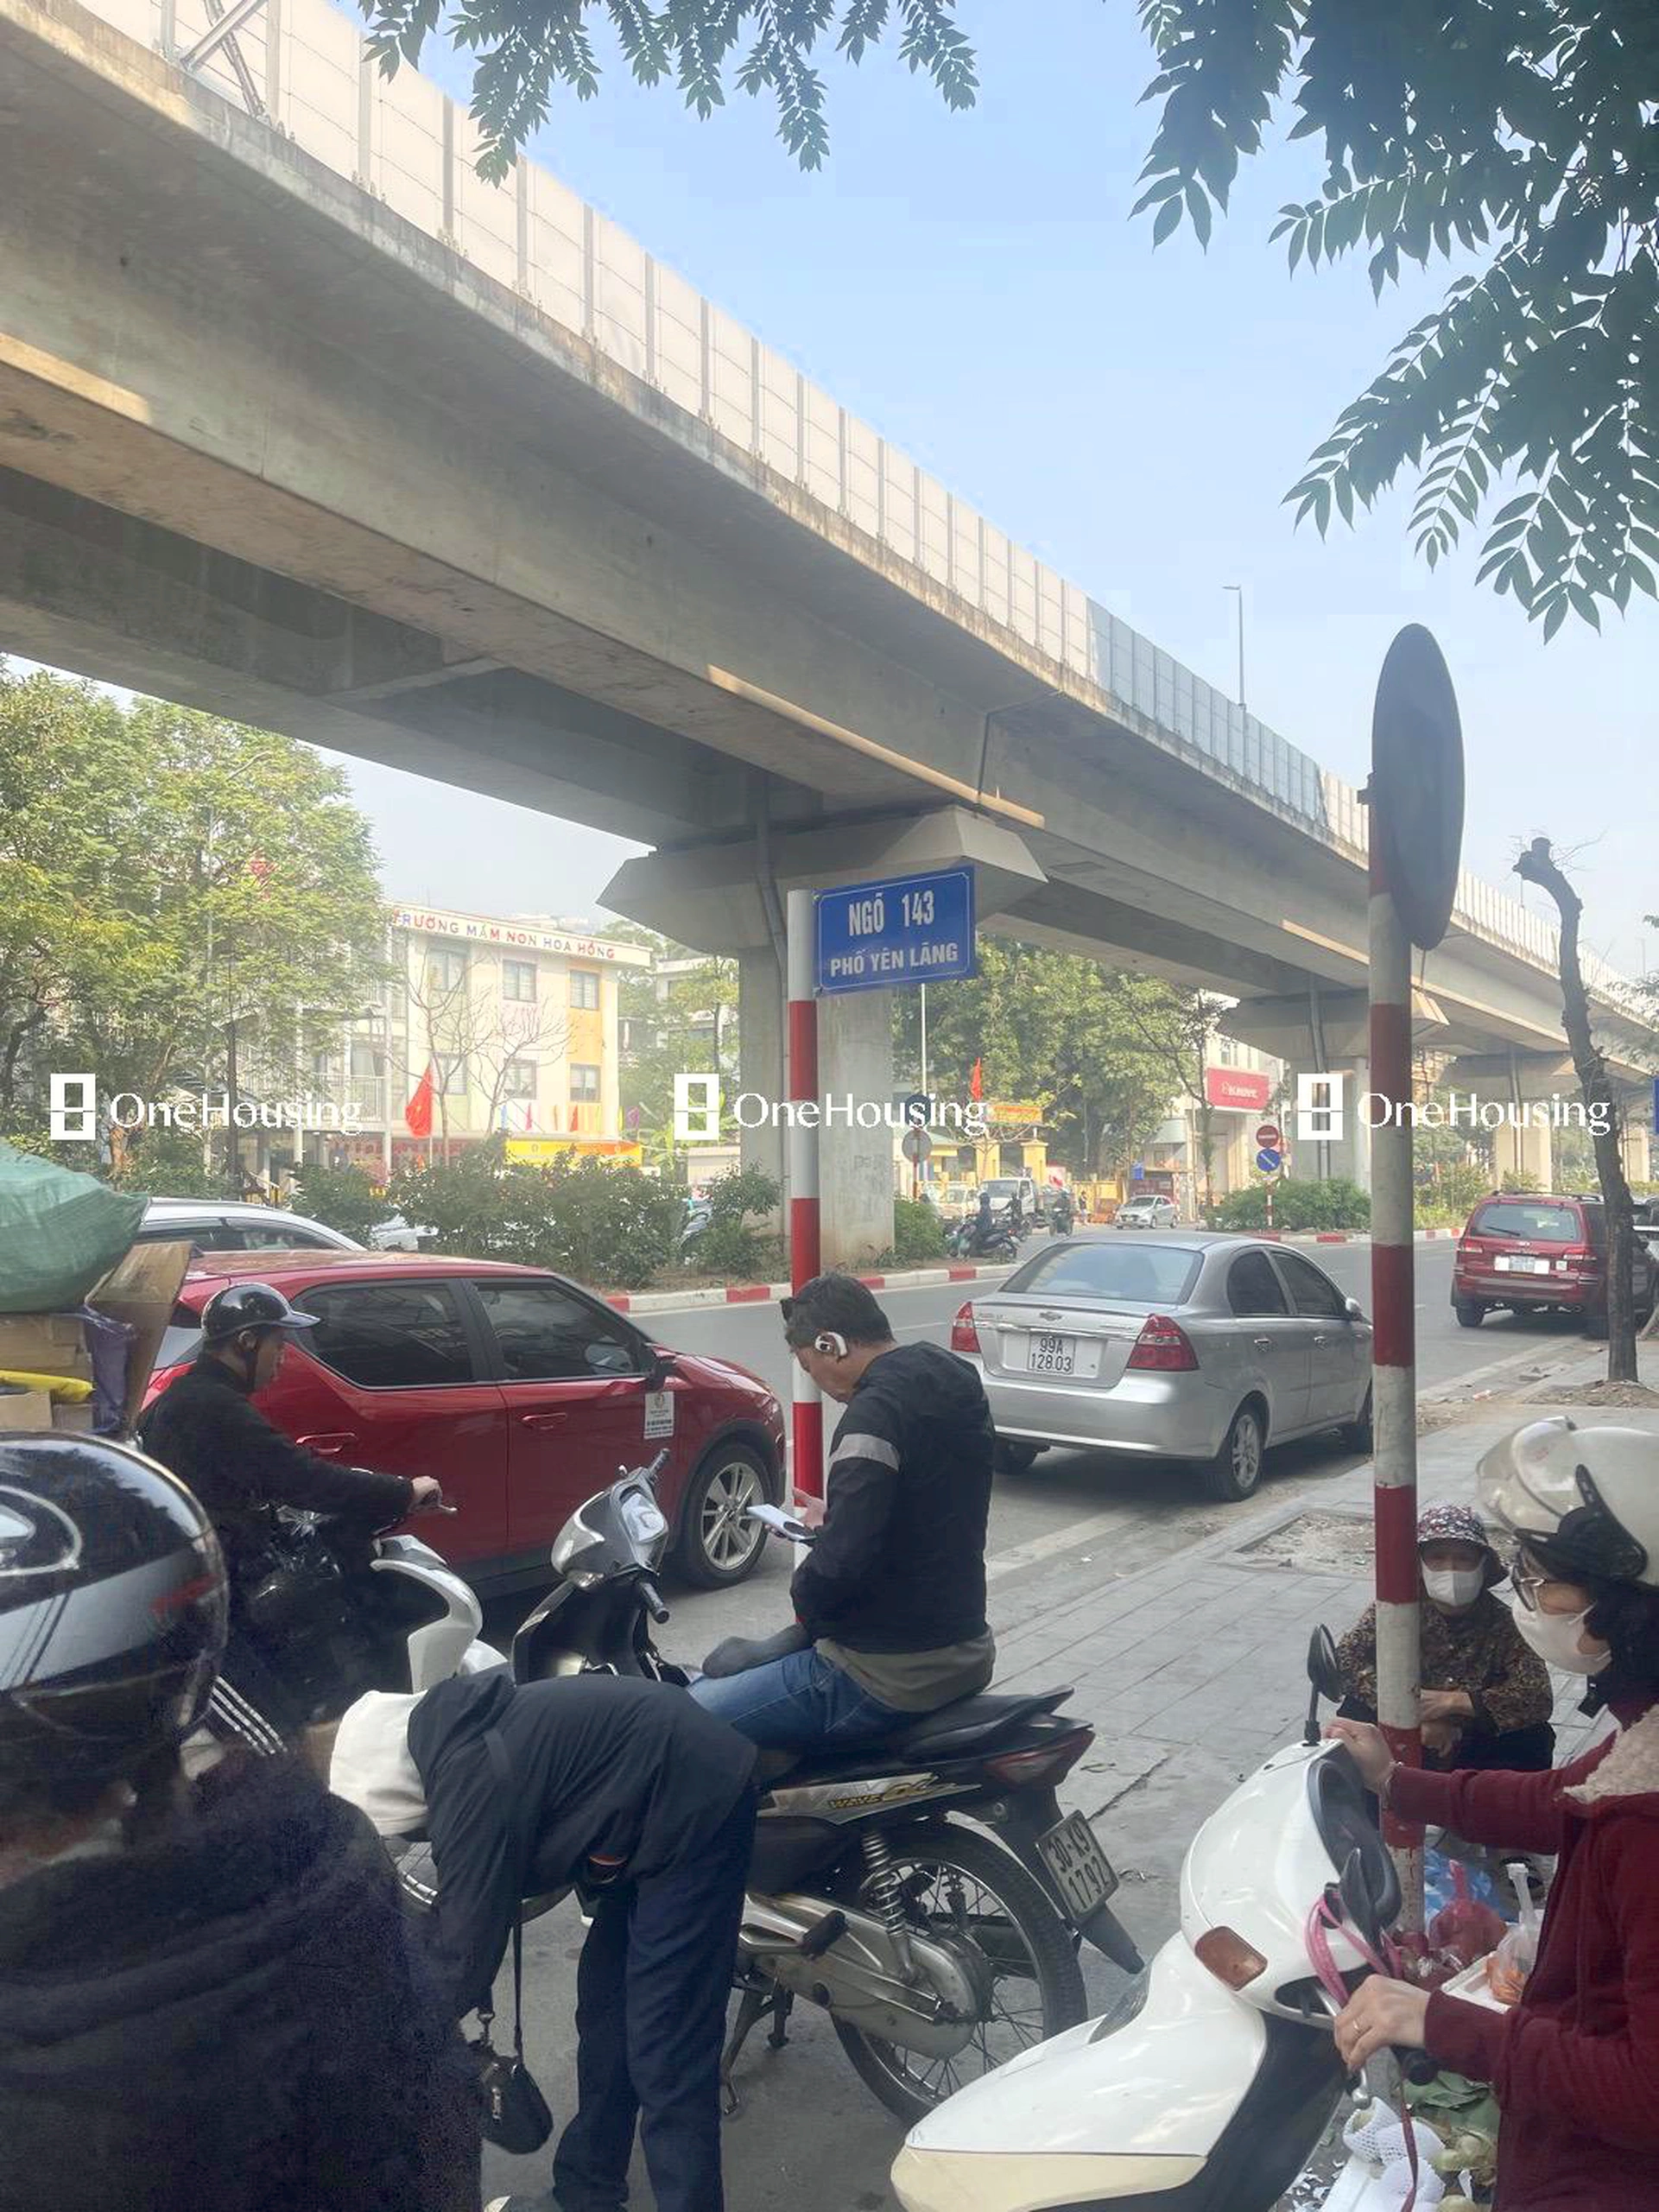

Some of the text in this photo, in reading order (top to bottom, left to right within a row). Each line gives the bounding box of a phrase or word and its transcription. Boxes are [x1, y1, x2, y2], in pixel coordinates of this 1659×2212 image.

[849, 890, 934, 936] NGÕ 143
[507, 932, 537, 946] NON
[544, 936, 572, 952] HOA
[830, 941, 959, 978] PHỐ YÊN LÃNG
[1039, 1337, 1063, 1355] 99A
[1067, 1855, 1109, 1909] 1792
